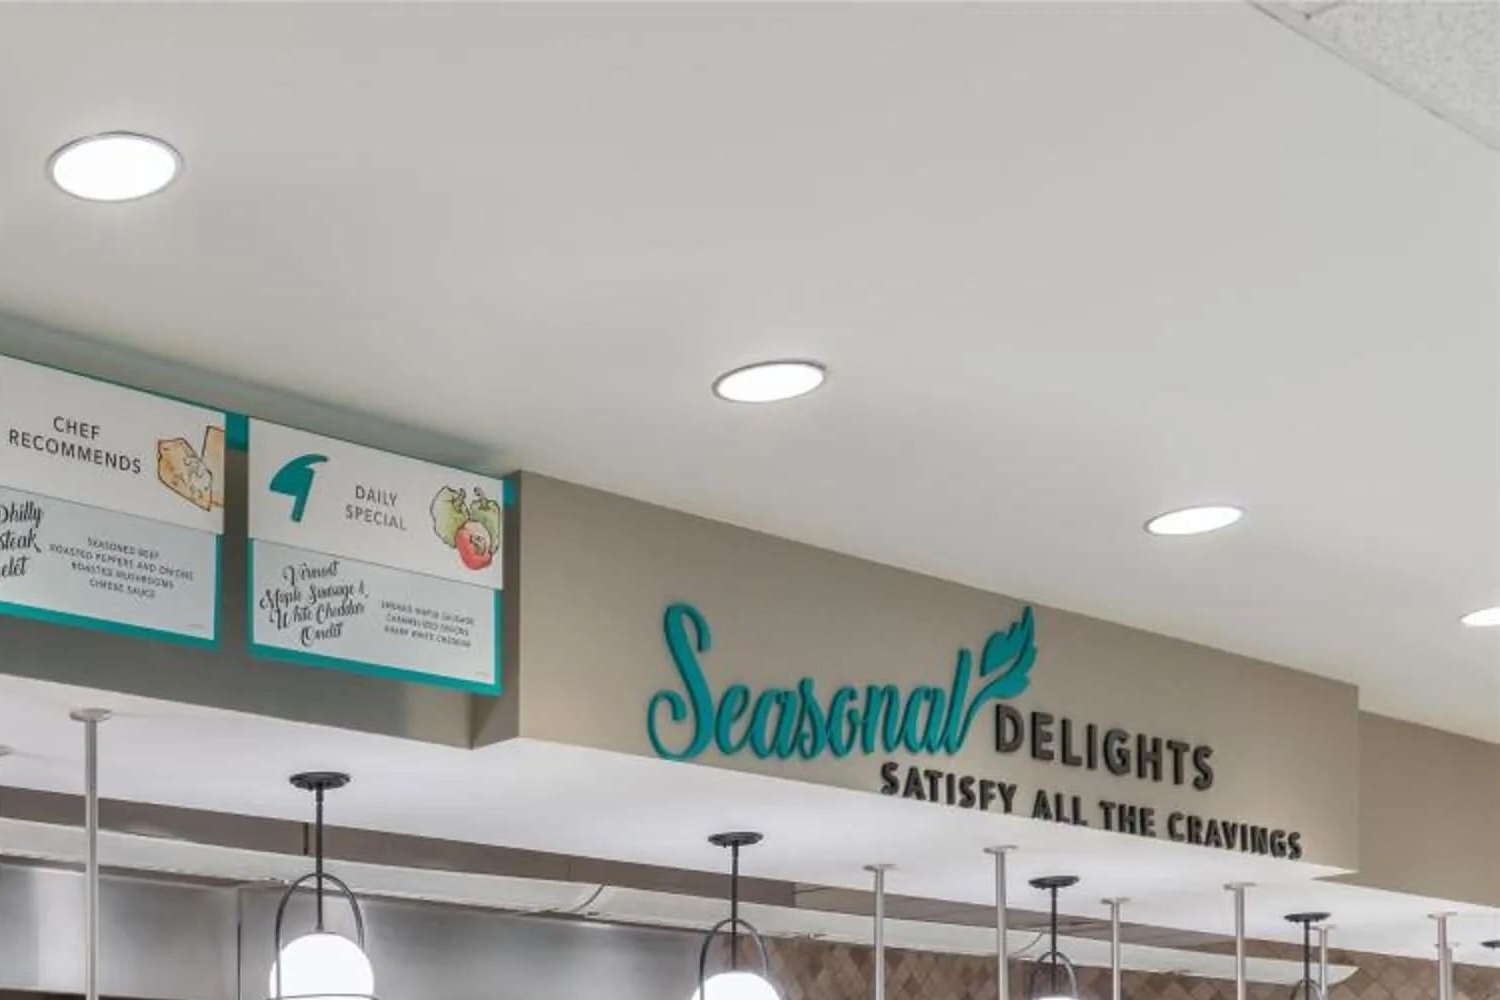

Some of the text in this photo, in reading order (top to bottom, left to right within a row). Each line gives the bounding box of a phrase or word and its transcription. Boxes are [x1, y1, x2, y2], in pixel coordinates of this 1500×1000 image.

[8, 429, 142, 474] RECOMMENDS
[53, 415, 101, 440] CHEF
[269, 453, 328, 523] 4
[355, 485, 398, 506] DAILY
[345, 504, 407, 531] SPECIAL
[647, 602, 990, 761] Seasonal
[994, 703, 1214, 792] DELIGHTS
[880, 762, 1303, 860] SATISFY ALL THE CRAVINGS
